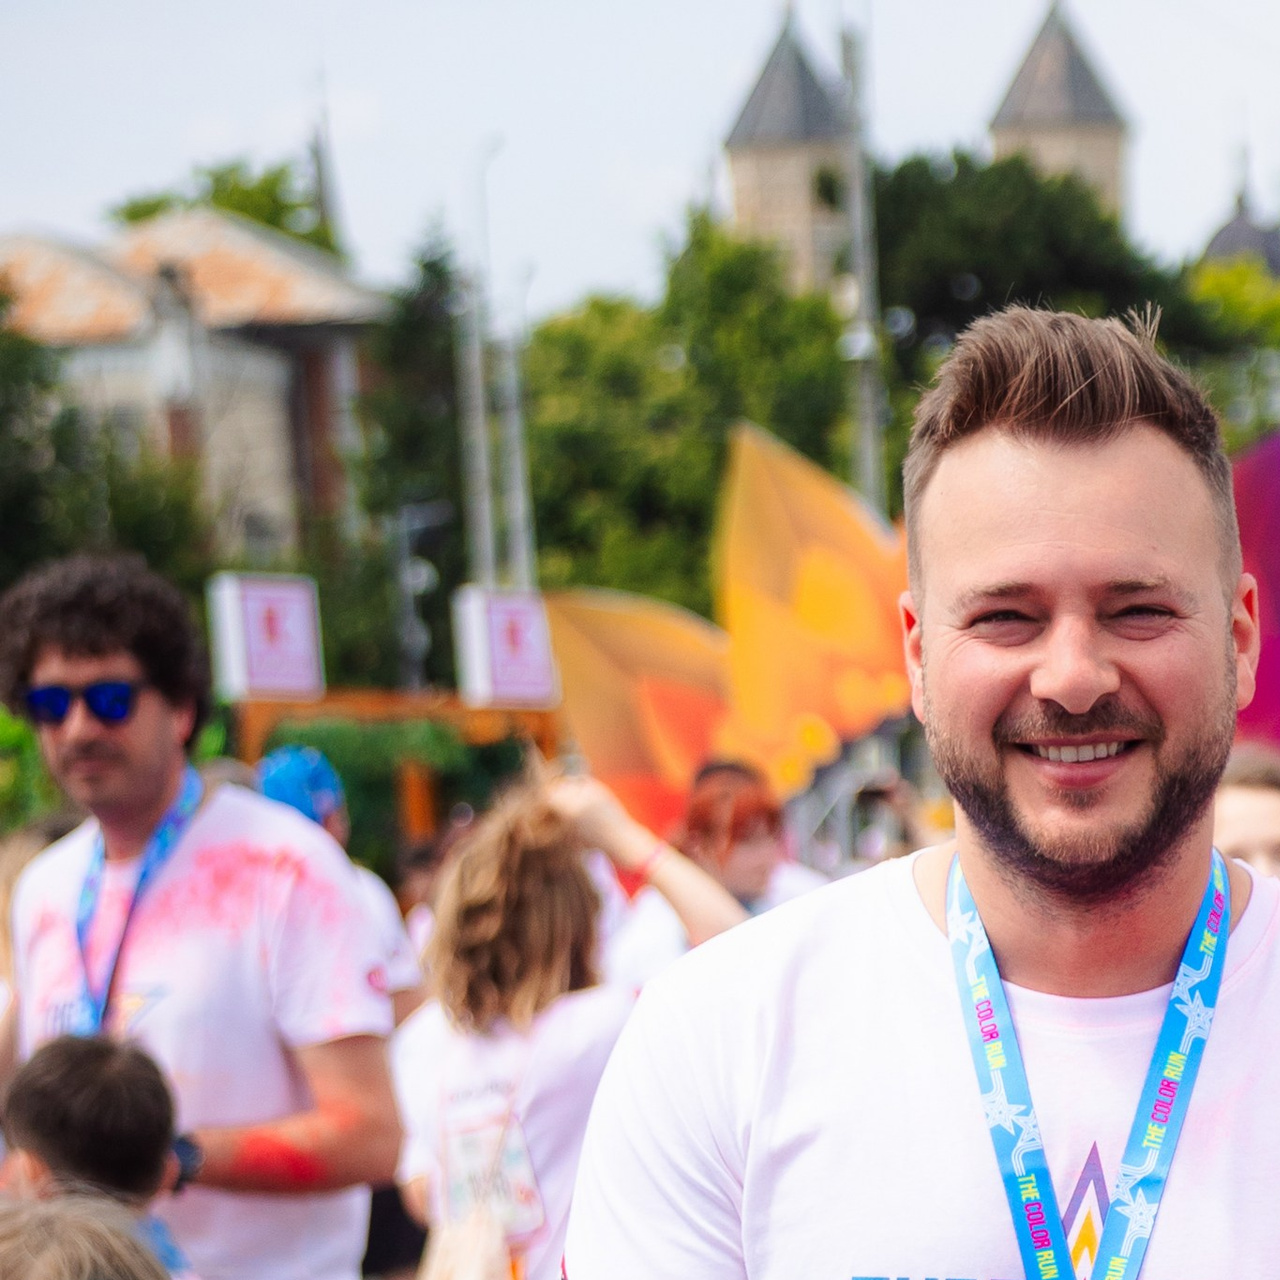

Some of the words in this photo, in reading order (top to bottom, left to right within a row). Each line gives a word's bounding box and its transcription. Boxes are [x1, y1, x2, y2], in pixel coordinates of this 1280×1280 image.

[1205, 889, 1225, 934] COLOR
[1199, 929, 1218, 957] THE
[970, 973, 990, 1002] THE
[975, 999, 1000, 1043] COLOR
[985, 1041, 1007, 1071] RUN
[1163, 1051, 1188, 1081] RUN
[1151, 1078, 1180, 1125] COLOR
[1142, 1123, 1167, 1150] THE
[1017, 1173, 1041, 1202] THE
[1025, 1202, 1051, 1250] COLOR
[1036, 1249, 1060, 1280] RUN
